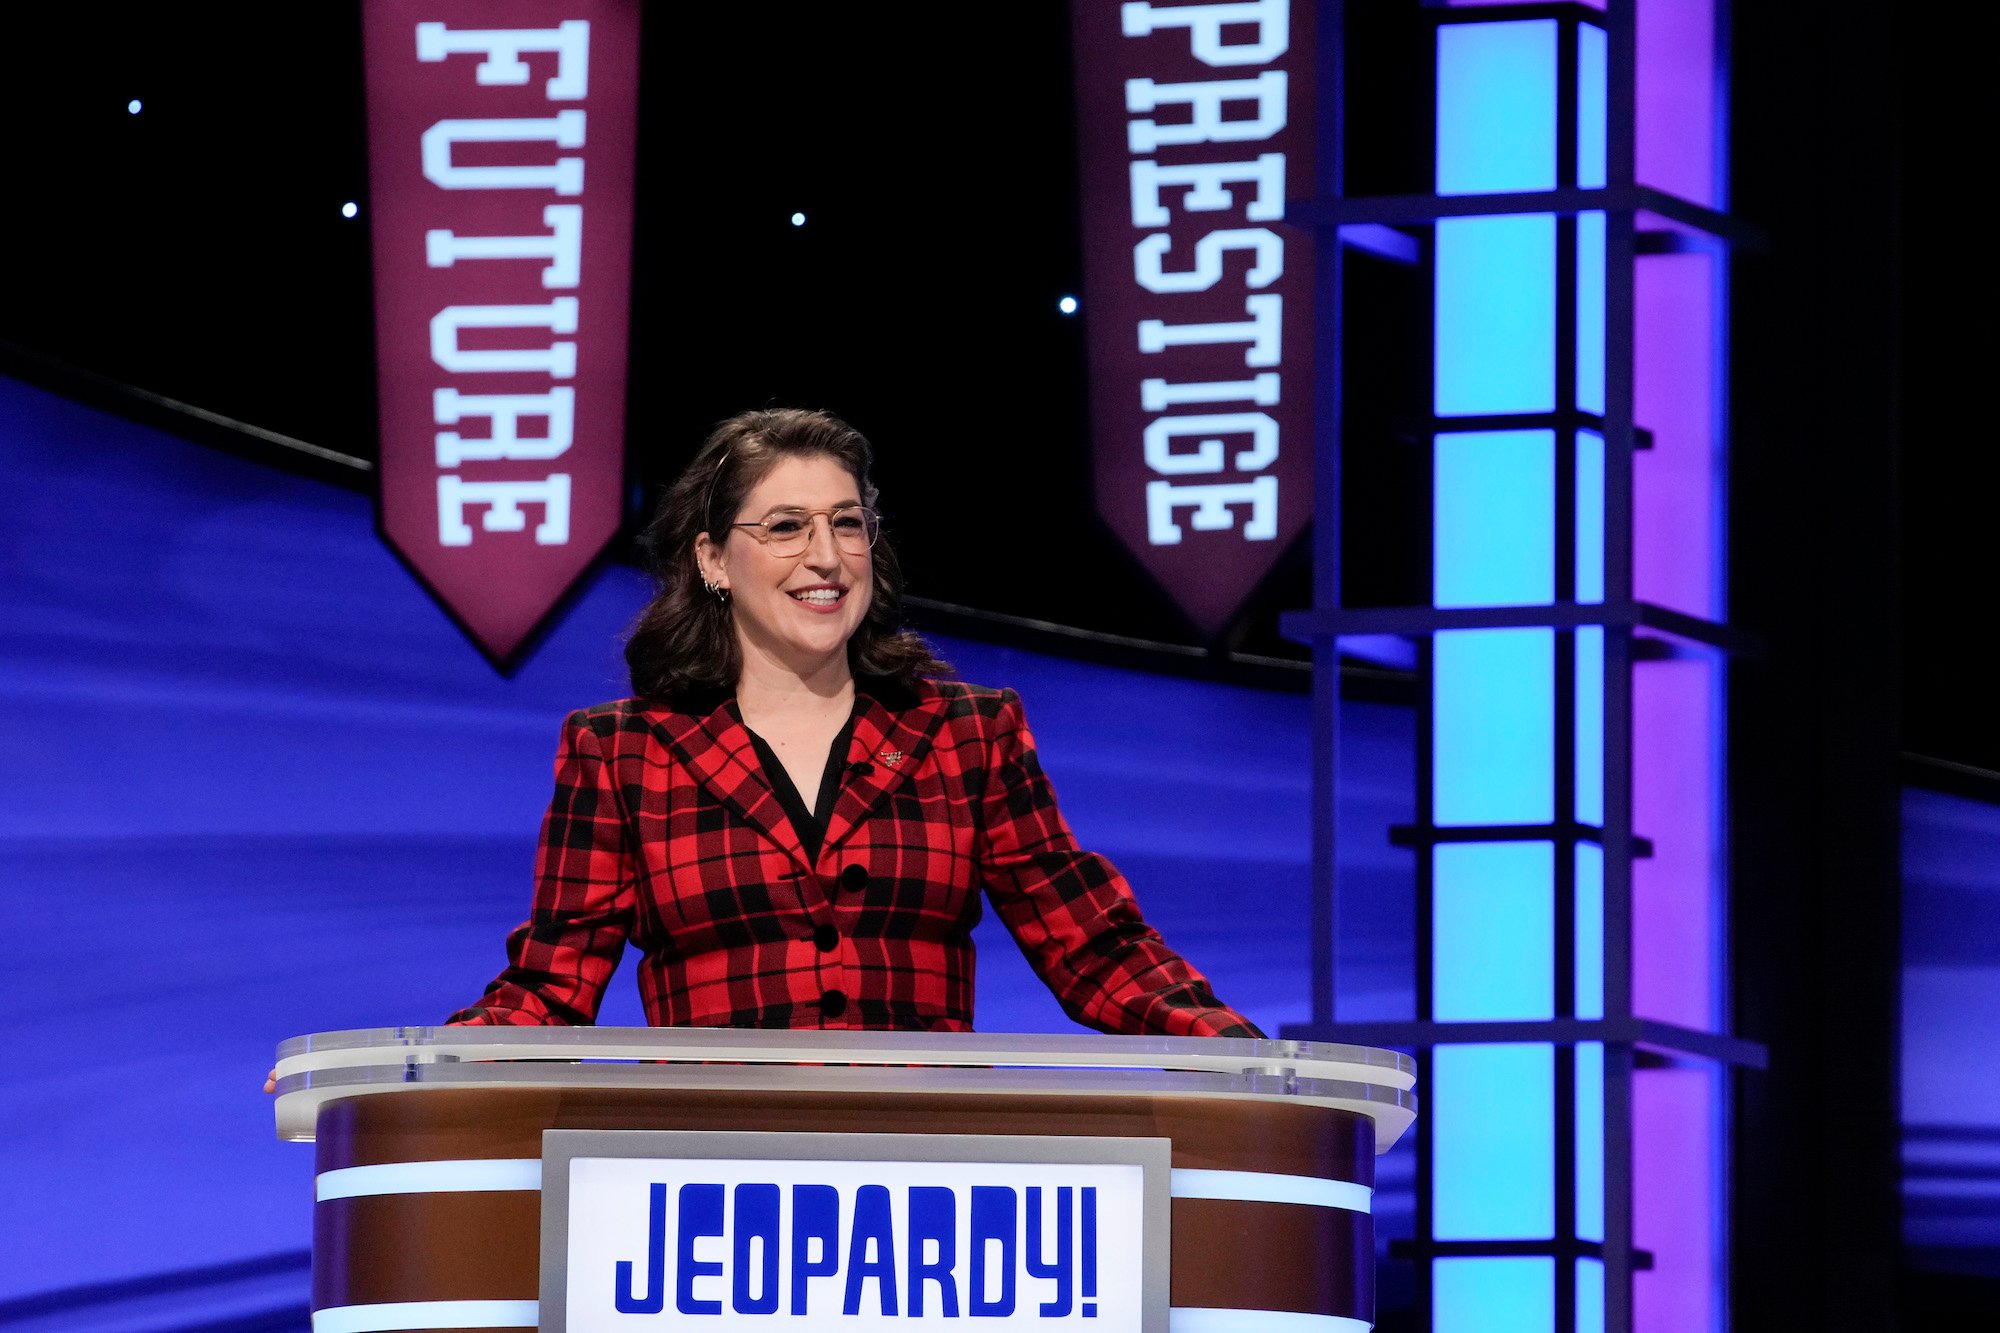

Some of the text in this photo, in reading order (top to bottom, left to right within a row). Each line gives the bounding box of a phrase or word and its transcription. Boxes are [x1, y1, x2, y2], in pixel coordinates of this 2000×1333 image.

[416, 20, 590, 547] FUTURE
[1121, 0, 1290, 545] PRESTIGE
[615, 1183, 1097, 1318] JEOPARDY!
